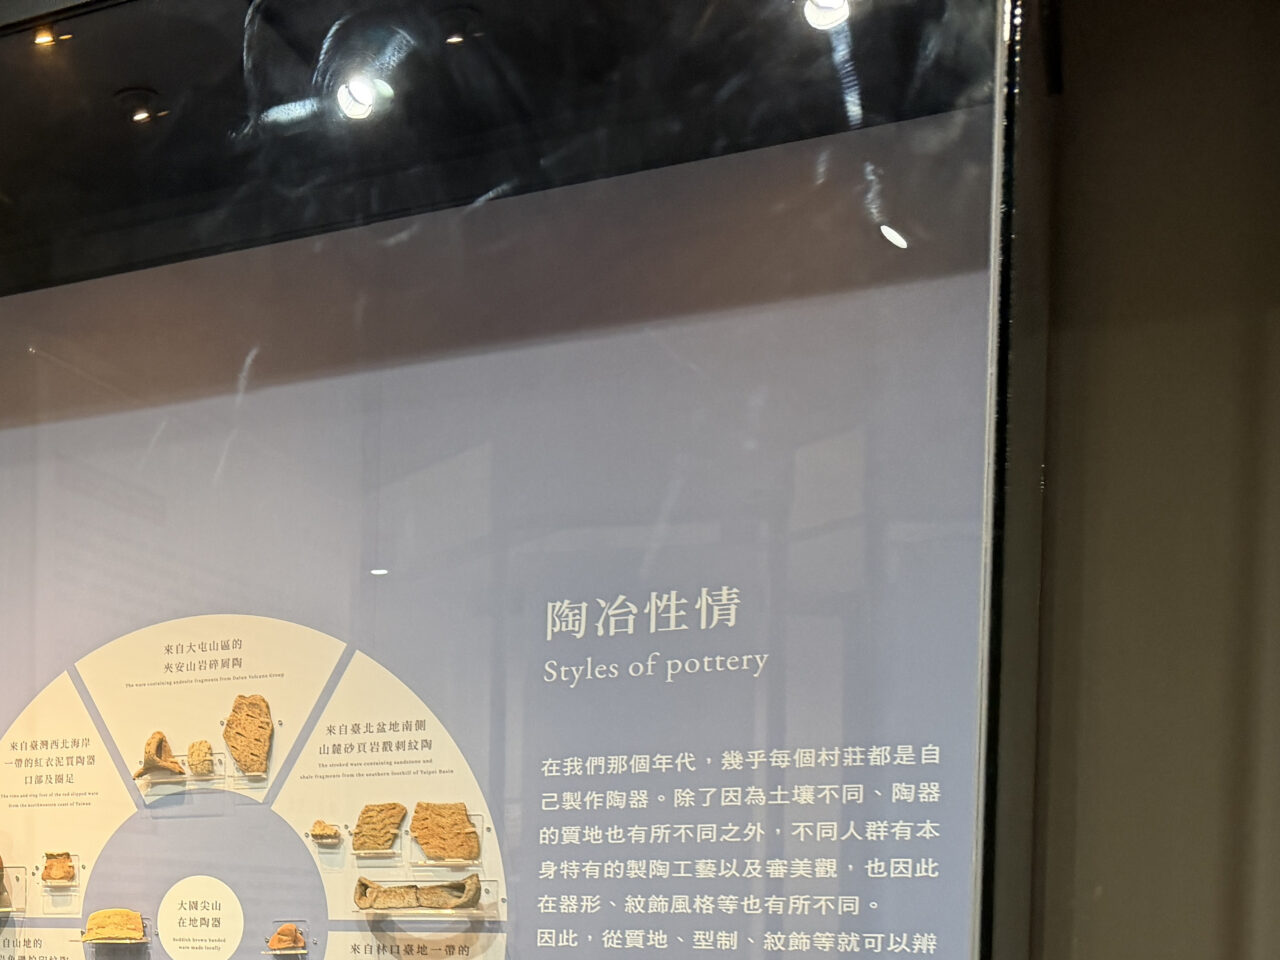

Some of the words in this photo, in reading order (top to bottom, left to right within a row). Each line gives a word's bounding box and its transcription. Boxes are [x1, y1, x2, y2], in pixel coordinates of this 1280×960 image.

[546, 586, 741, 641] 陶冶性情
[164, 639, 242, 655] 來自大屯山區的
[543, 658, 619, 689] Styles
[629, 652, 658, 677] of
[666, 653, 769, 683] pottery
[326, 719, 426, 735] 來自臺北盆地南側
[541, 744, 940, 776] 在我們那個年代，幾乎每個村莊都是自
[541, 783, 940, 811] 己製作陶器。除了因為土壤不同、陶器
[539, 820, 940, 845] 的質地也有所不同之外，不同人群有本
[538, 858, 939, 880] 身特有的製陶工藝以及審美觀，也因此
[538, 894, 878, 915] 在器形、紋飾風格等也有所不同。
[178, 916, 221, 928] 在地陶器
